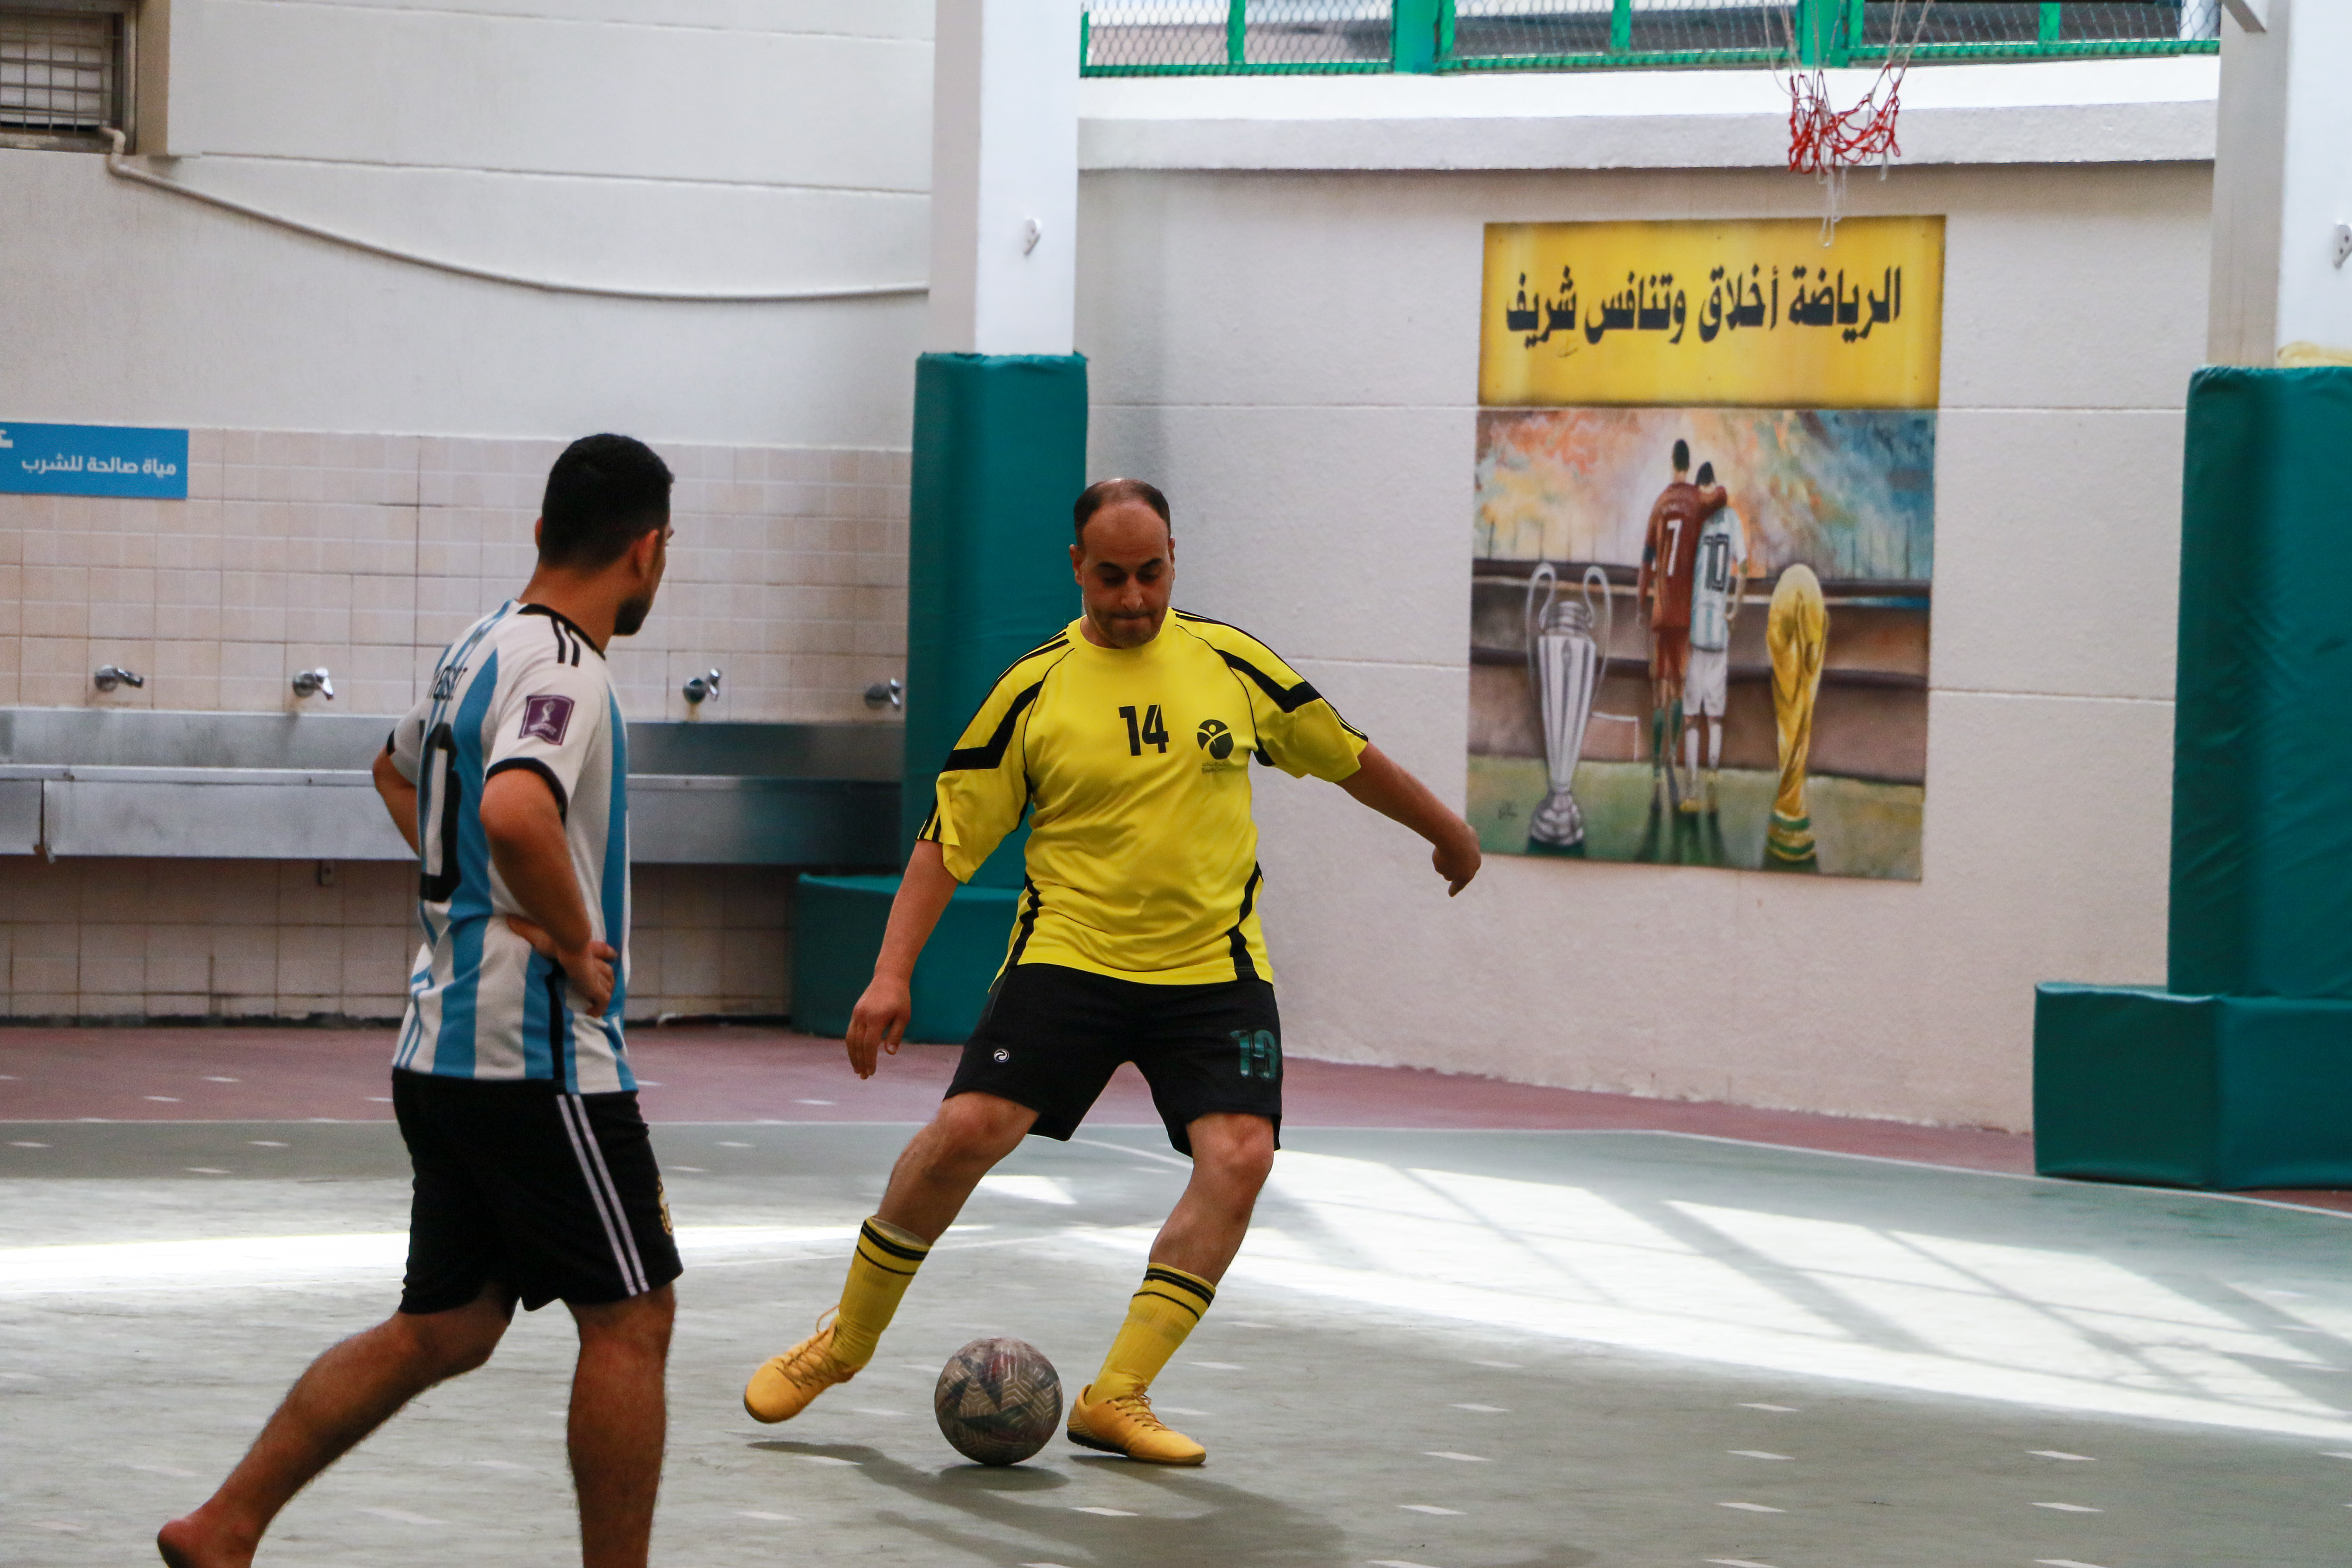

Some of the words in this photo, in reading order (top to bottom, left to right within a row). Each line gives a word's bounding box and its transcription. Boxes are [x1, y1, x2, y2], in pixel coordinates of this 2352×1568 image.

[1507, 266, 1576, 347] شريف
[1585, 273, 1685, 343] وتنافس
[1700, 265, 1777, 341] أخلاق
[1790, 267, 1900, 342] الرياضة
[22, 454, 83, 474] للشرب
[87, 457, 138, 473] صالحة
[1703, 533, 1729, 592] 10
[1119, 704, 1169, 756] 14
